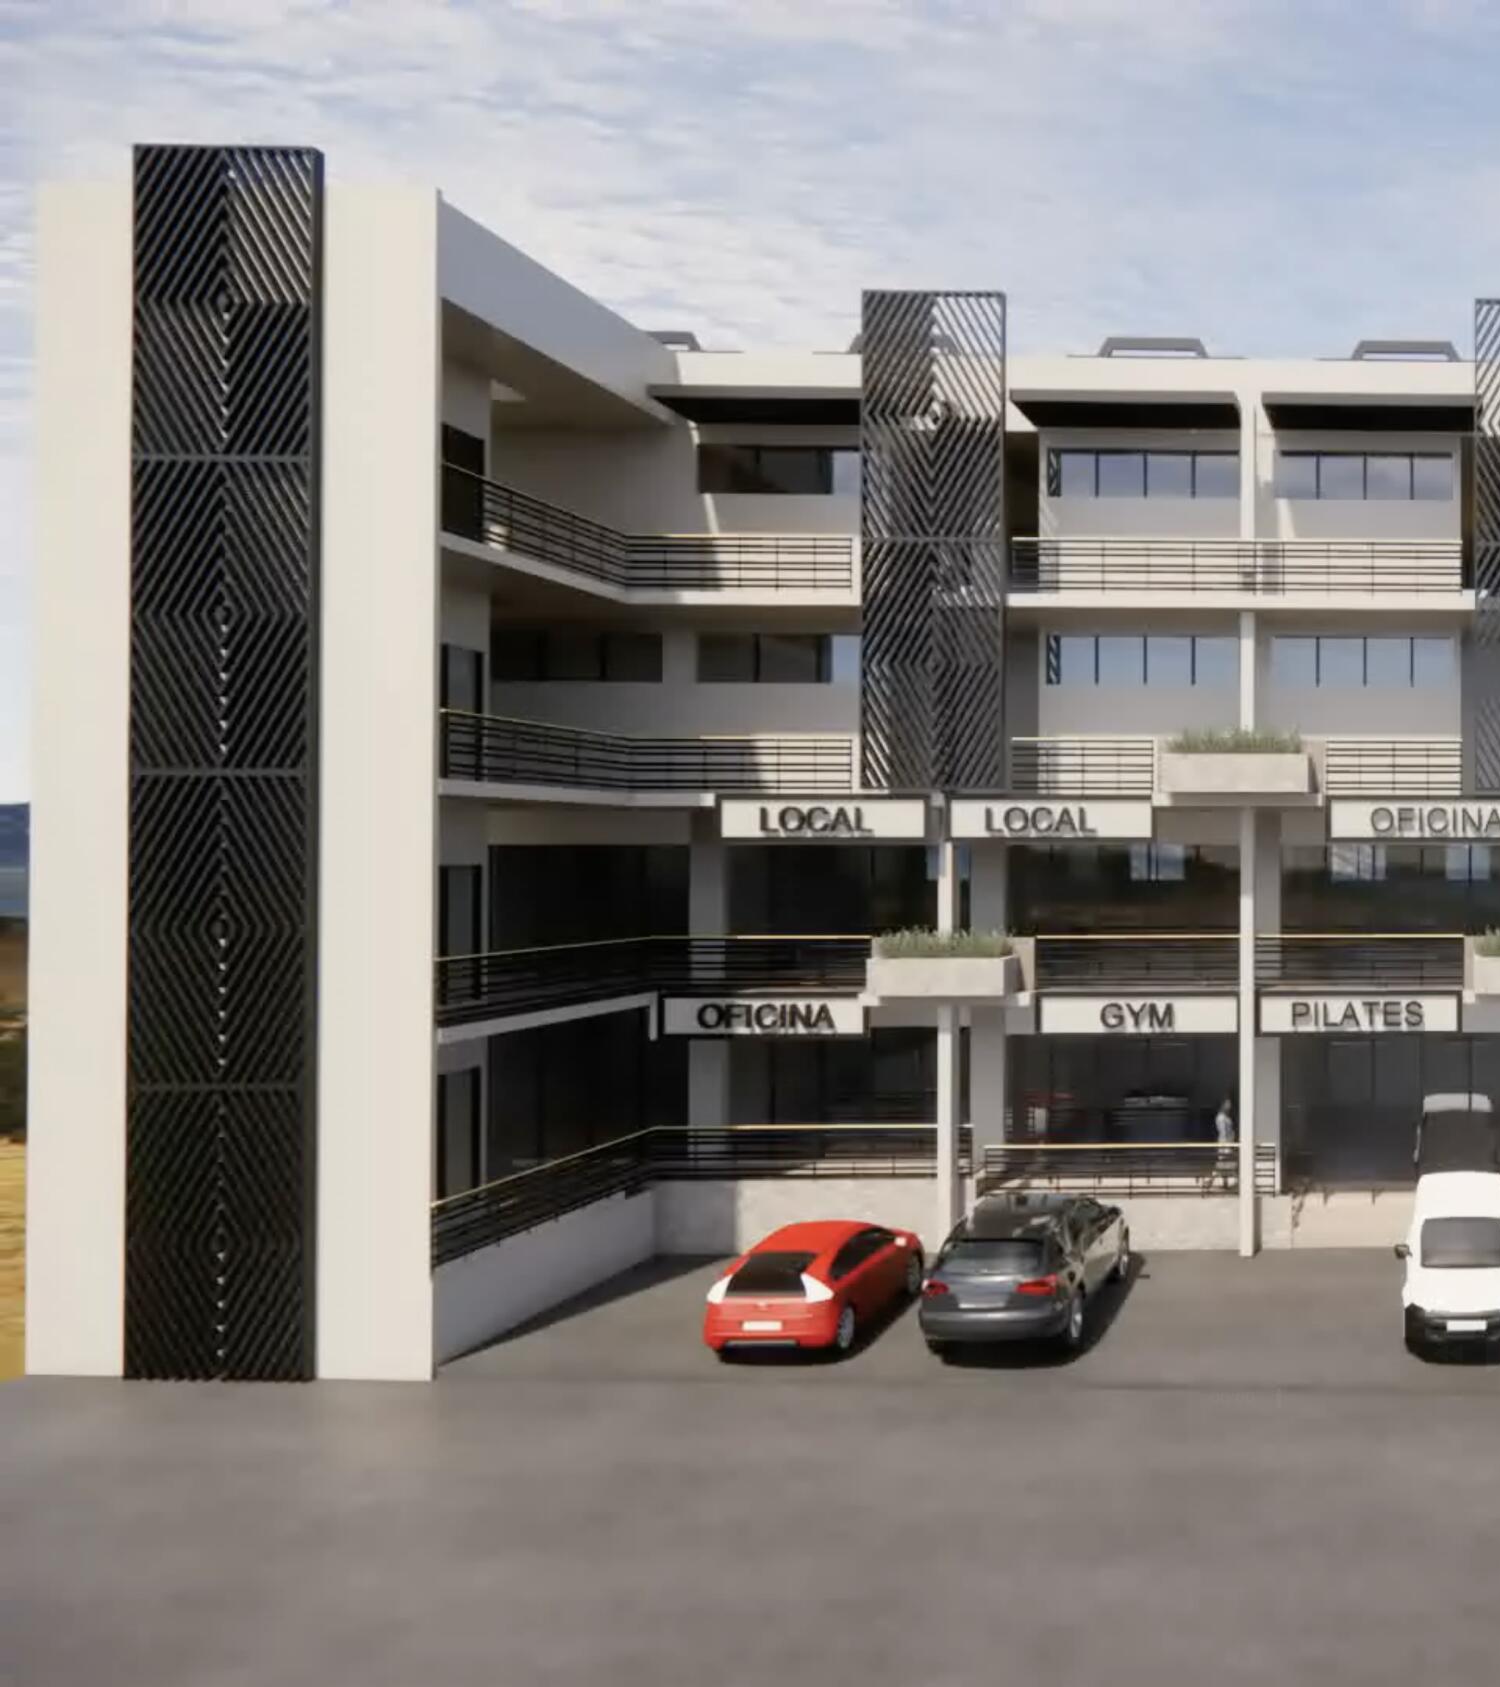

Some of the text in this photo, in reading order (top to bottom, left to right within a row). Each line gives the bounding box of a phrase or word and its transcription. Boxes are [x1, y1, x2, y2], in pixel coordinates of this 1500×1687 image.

[760, 806, 874, 833] LOCAL
[985, 806, 1098, 834] LOCAL
[696, 1002, 836, 1030] OFICINA
[1099, 1002, 1175, 1029] GYM
[1291, 1001, 1424, 1028] PILATES
